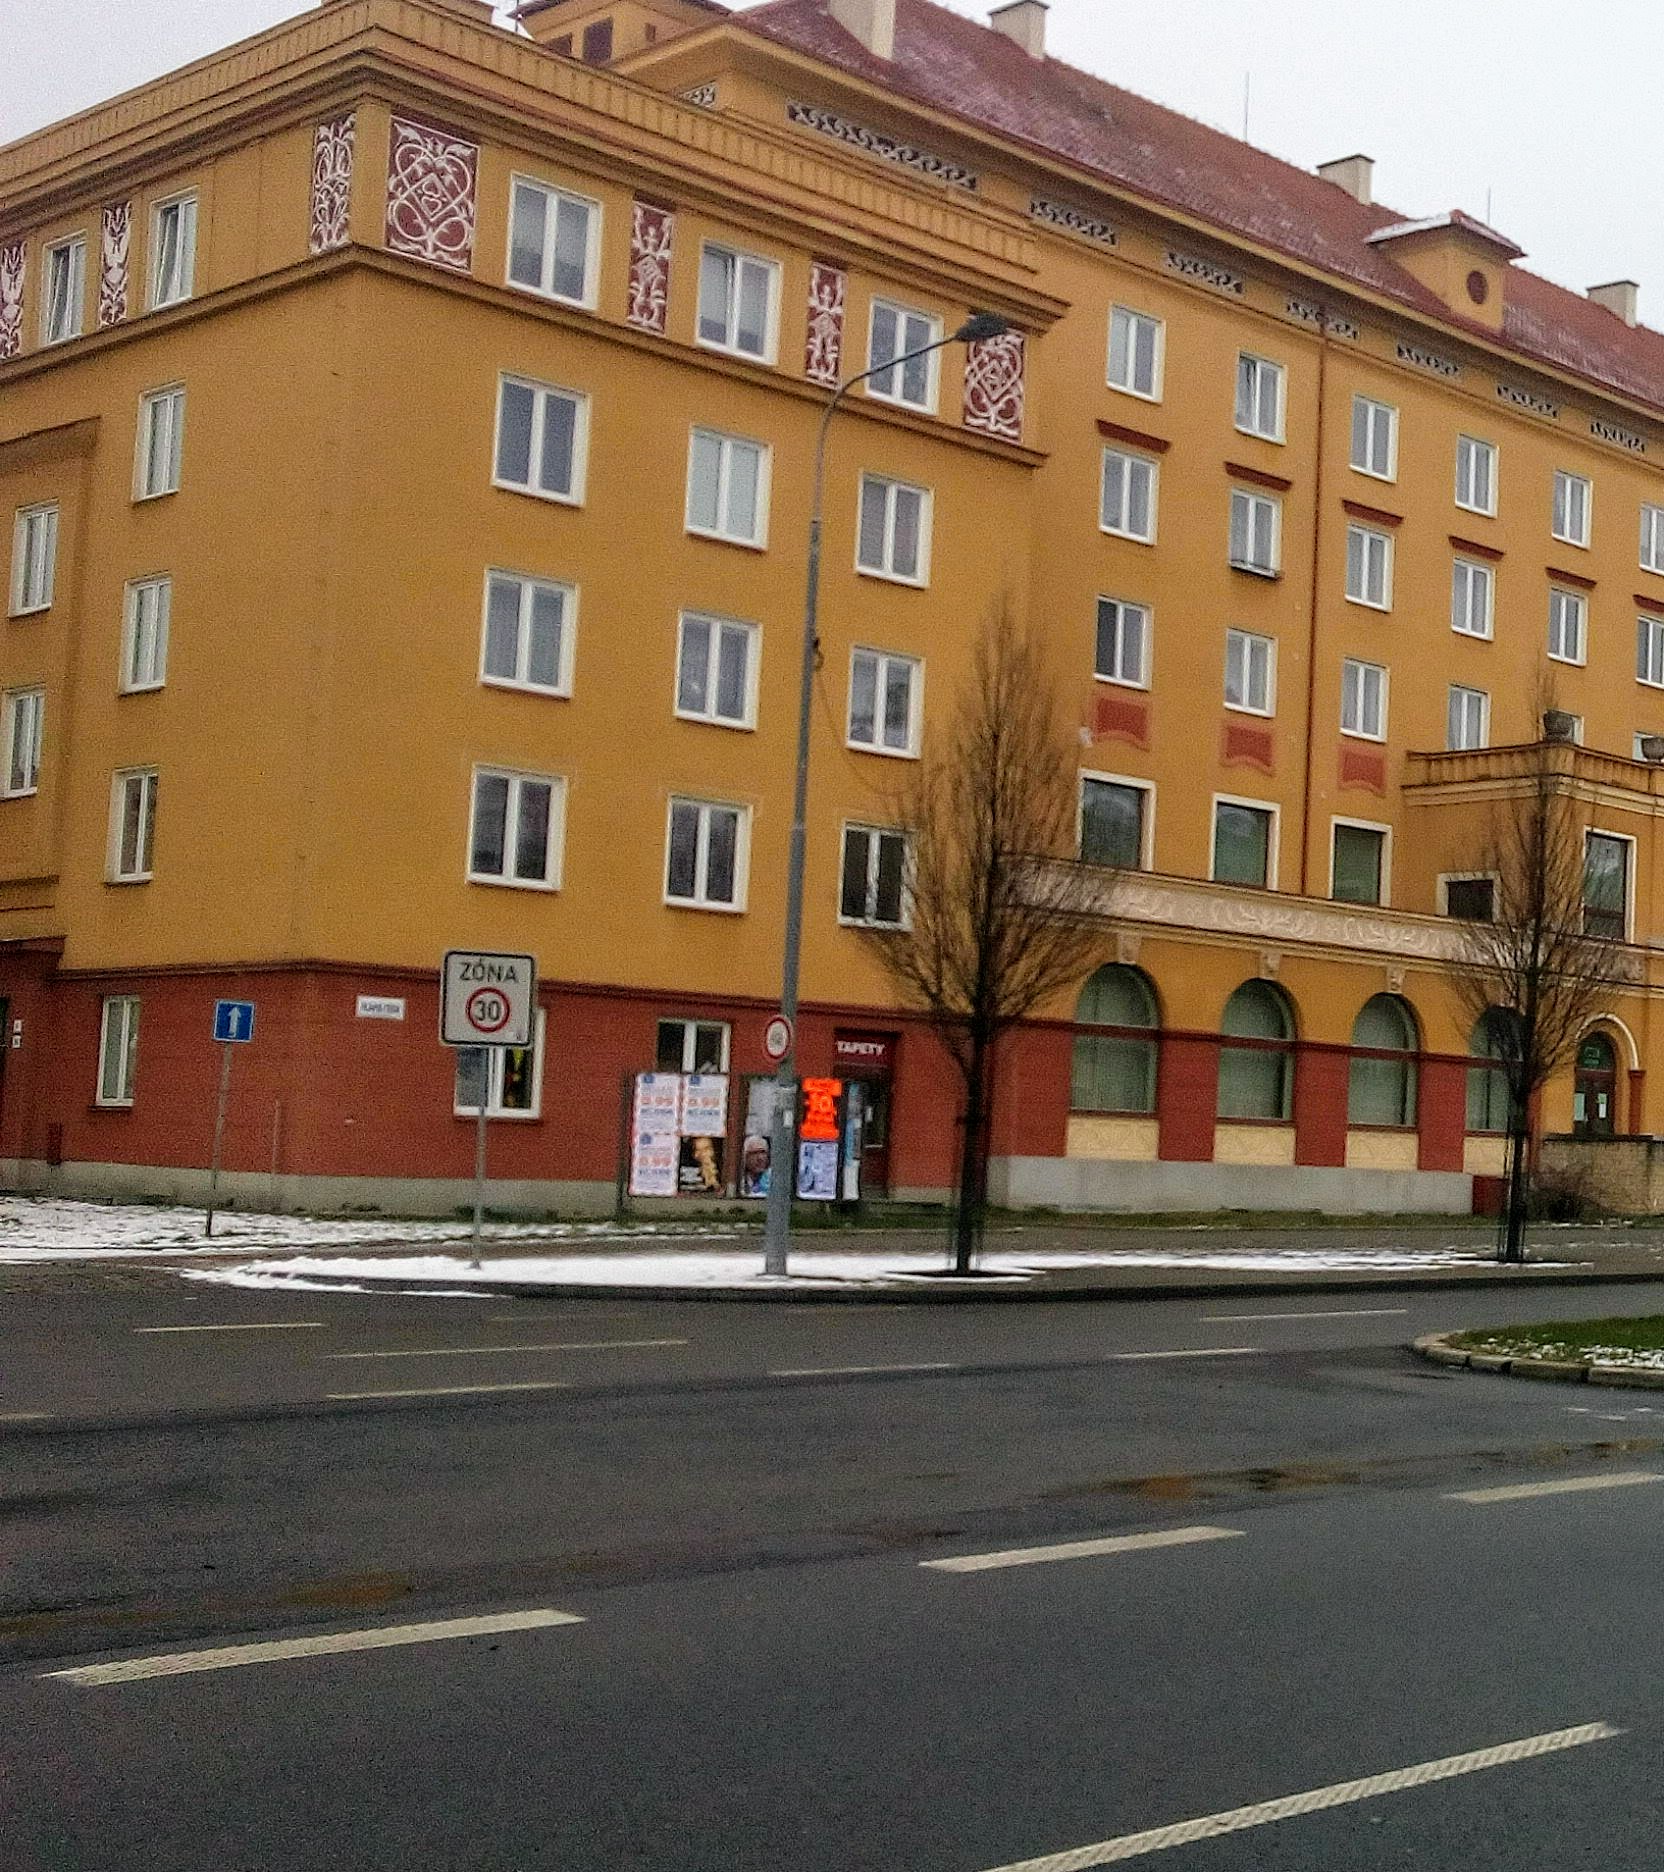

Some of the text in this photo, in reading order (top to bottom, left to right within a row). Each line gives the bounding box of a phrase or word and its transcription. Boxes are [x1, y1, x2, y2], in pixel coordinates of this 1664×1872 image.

[459, 957, 519, 983] ZÓNA
[475, 1000, 500, 1021] 30
[835, 1040, 886, 1056] TAPETY
